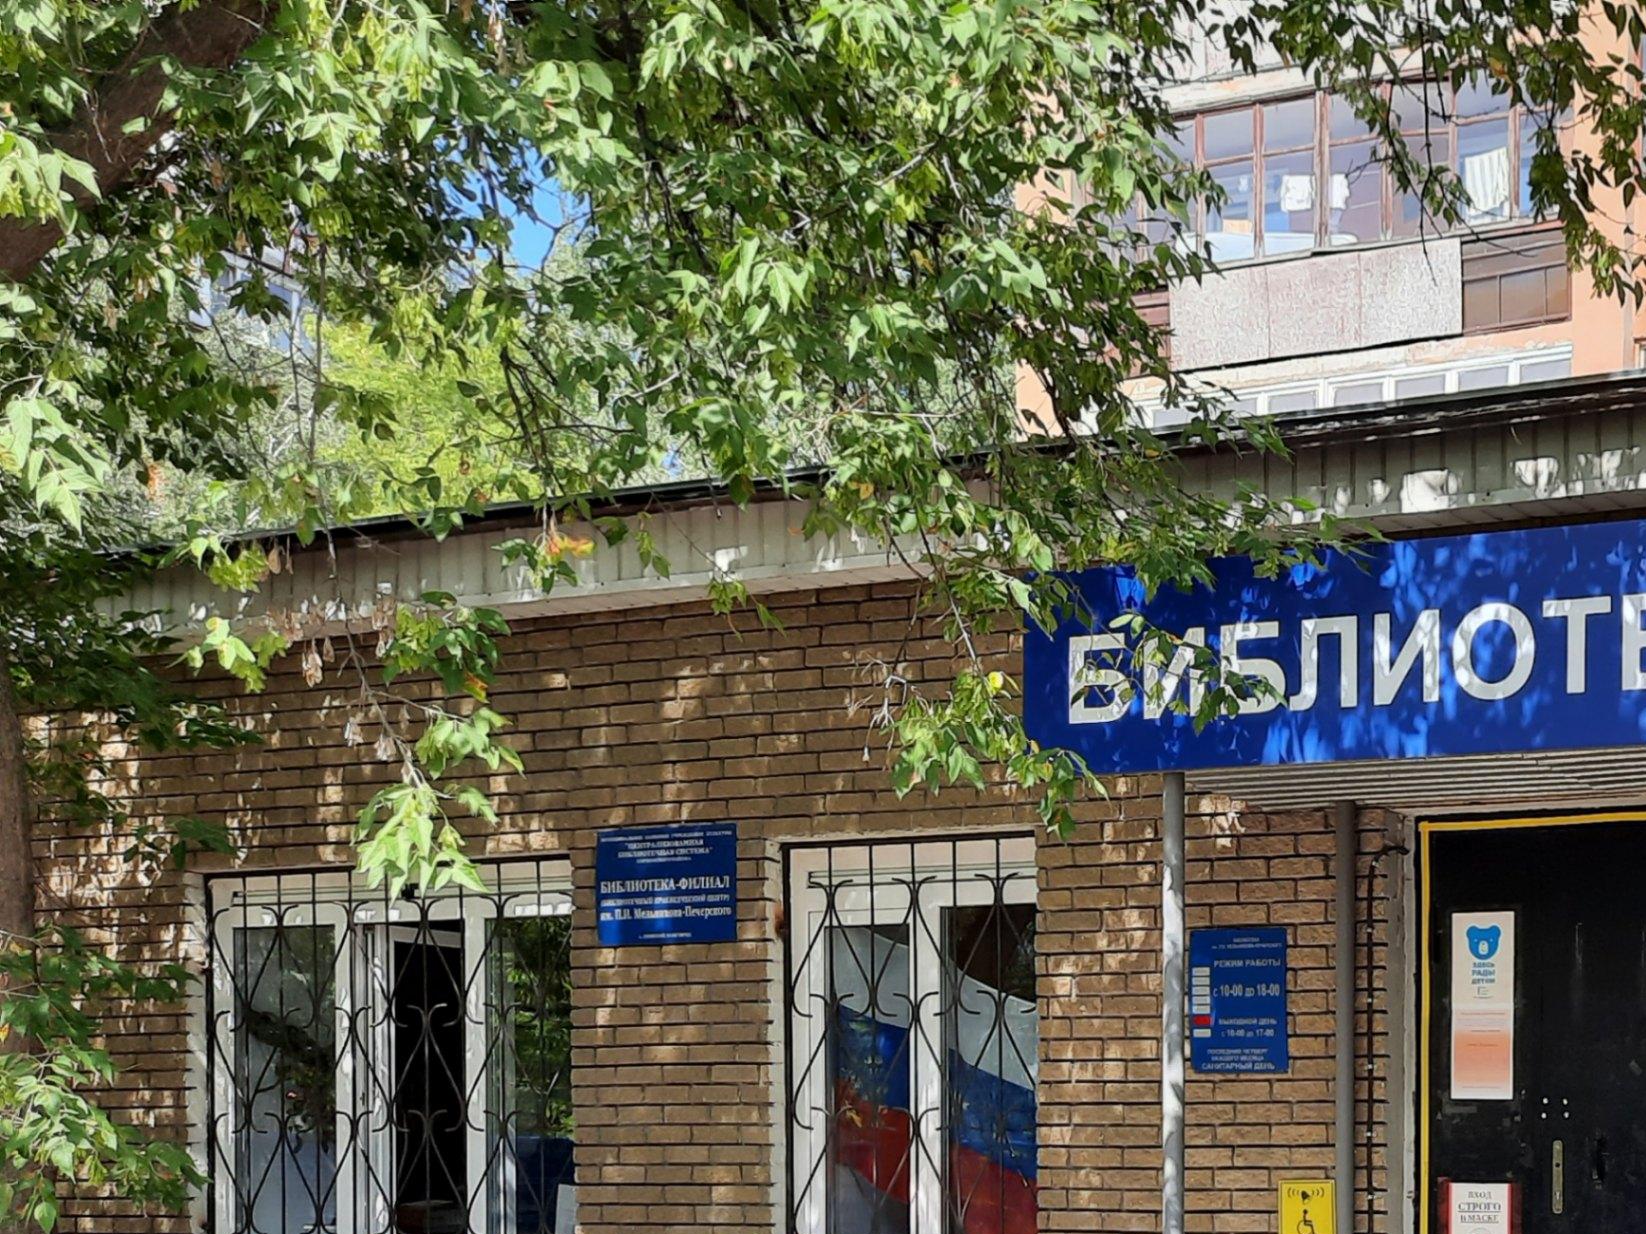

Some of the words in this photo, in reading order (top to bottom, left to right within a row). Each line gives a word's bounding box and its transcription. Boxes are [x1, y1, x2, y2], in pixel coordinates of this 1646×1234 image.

[600, 875, 730, 894] БИБЛИОТЕКА-ФИЛИАЛ
[1214, 959, 1244, 968] РЕЖИМ
[1245, 958, 1281, 967] РАБОТЫ
[1220, 984, 1243, 997] 10-00
[1257, 983, 1280, 996] 18-00
[1468, 1191, 1492, 1200] ВХОД
[1458, 1202, 1501, 1211] СТРОГО
[1467, 1214, 1499, 1222] МАСКЕ
